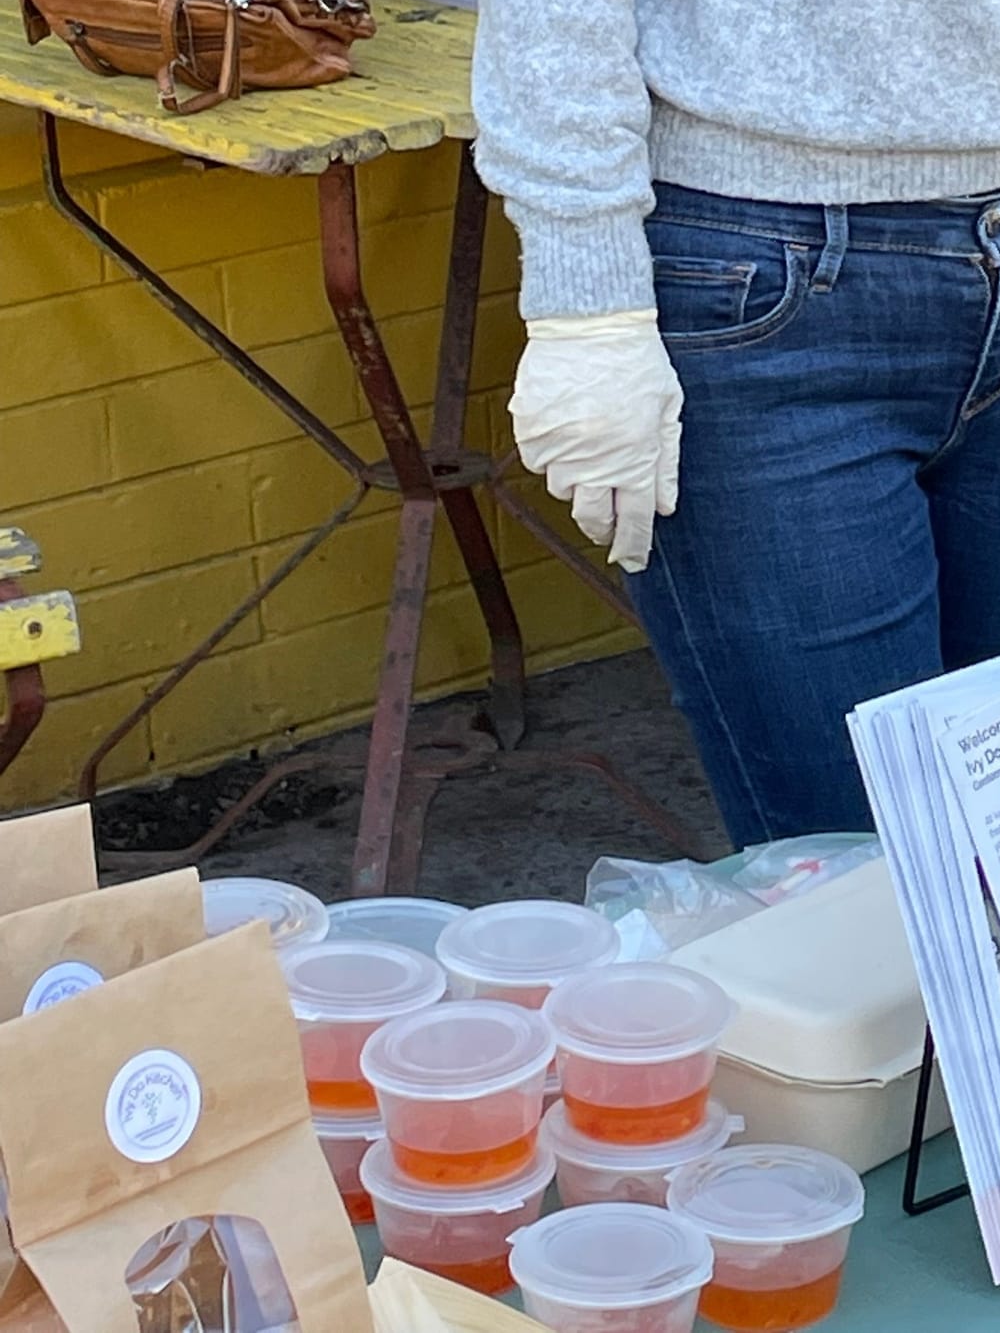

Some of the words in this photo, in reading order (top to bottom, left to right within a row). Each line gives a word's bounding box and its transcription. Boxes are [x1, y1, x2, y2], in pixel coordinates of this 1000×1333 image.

[965, 757, 985, 776] Ivy
[127, 1081, 145, 1100] Do
[145, 1073, 182, 1101] Kitchen
